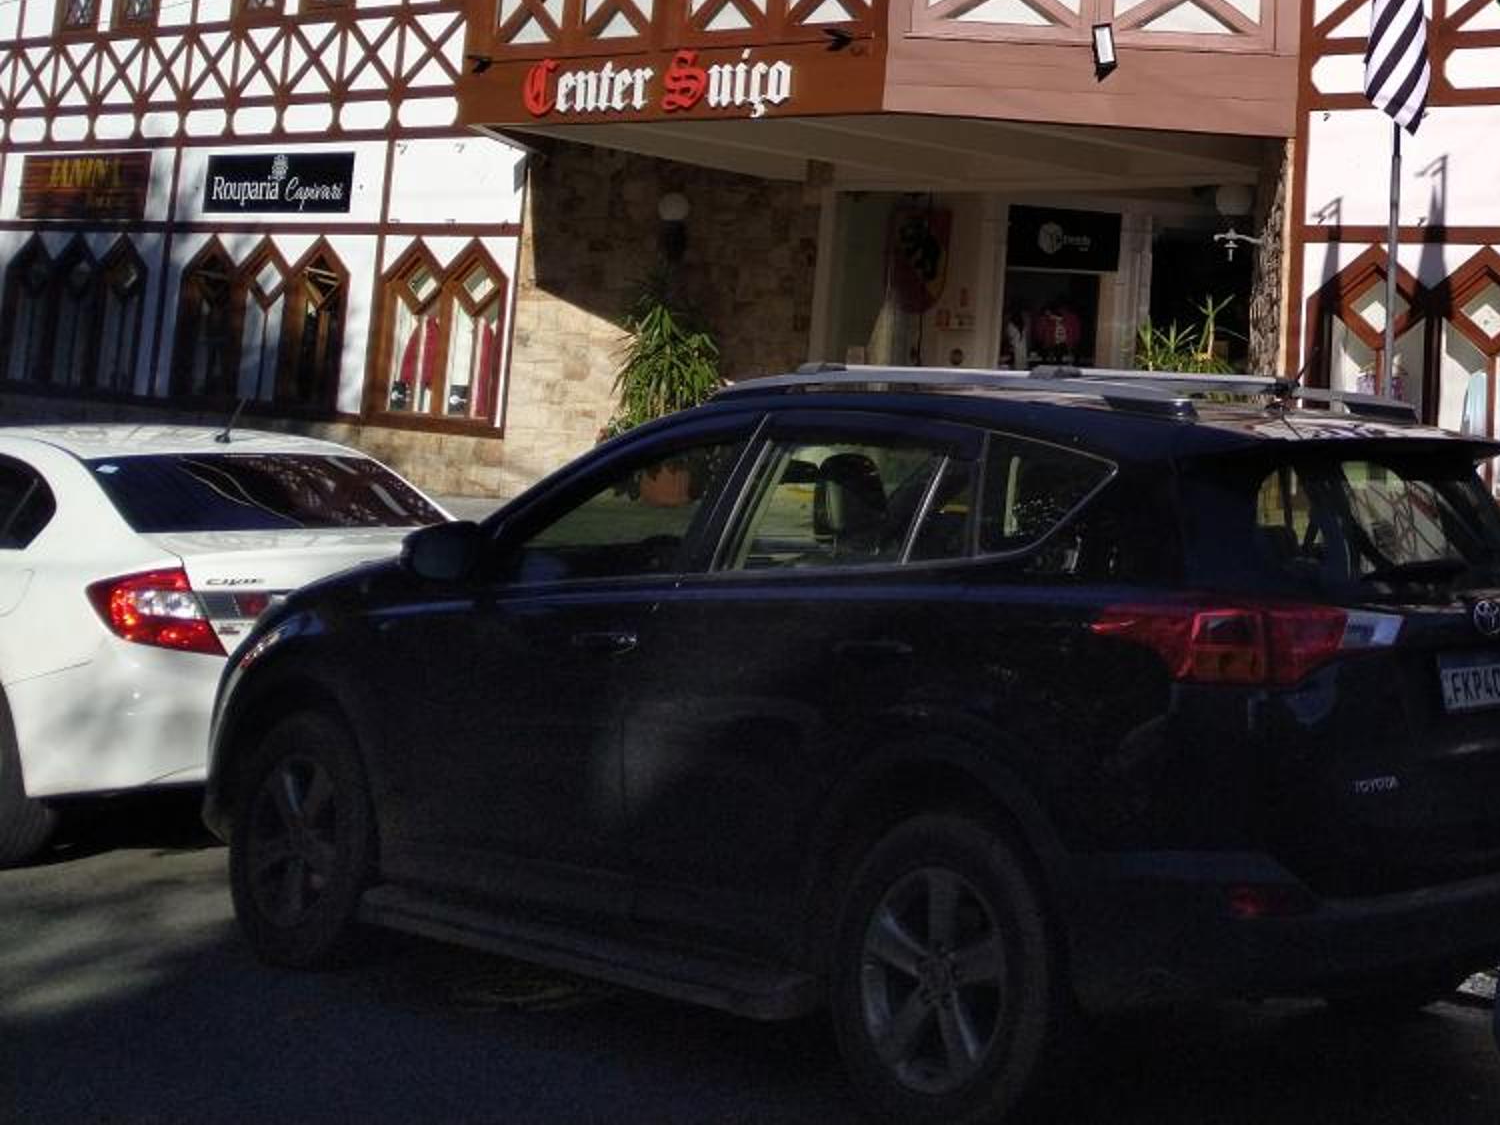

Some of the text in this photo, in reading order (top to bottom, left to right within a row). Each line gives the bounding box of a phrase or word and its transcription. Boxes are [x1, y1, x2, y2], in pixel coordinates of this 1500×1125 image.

[522, 58, 655, 118] Center
[211, 175, 280, 207] Rouparia
[1353, 774, 1400, 795] TOYOTA
